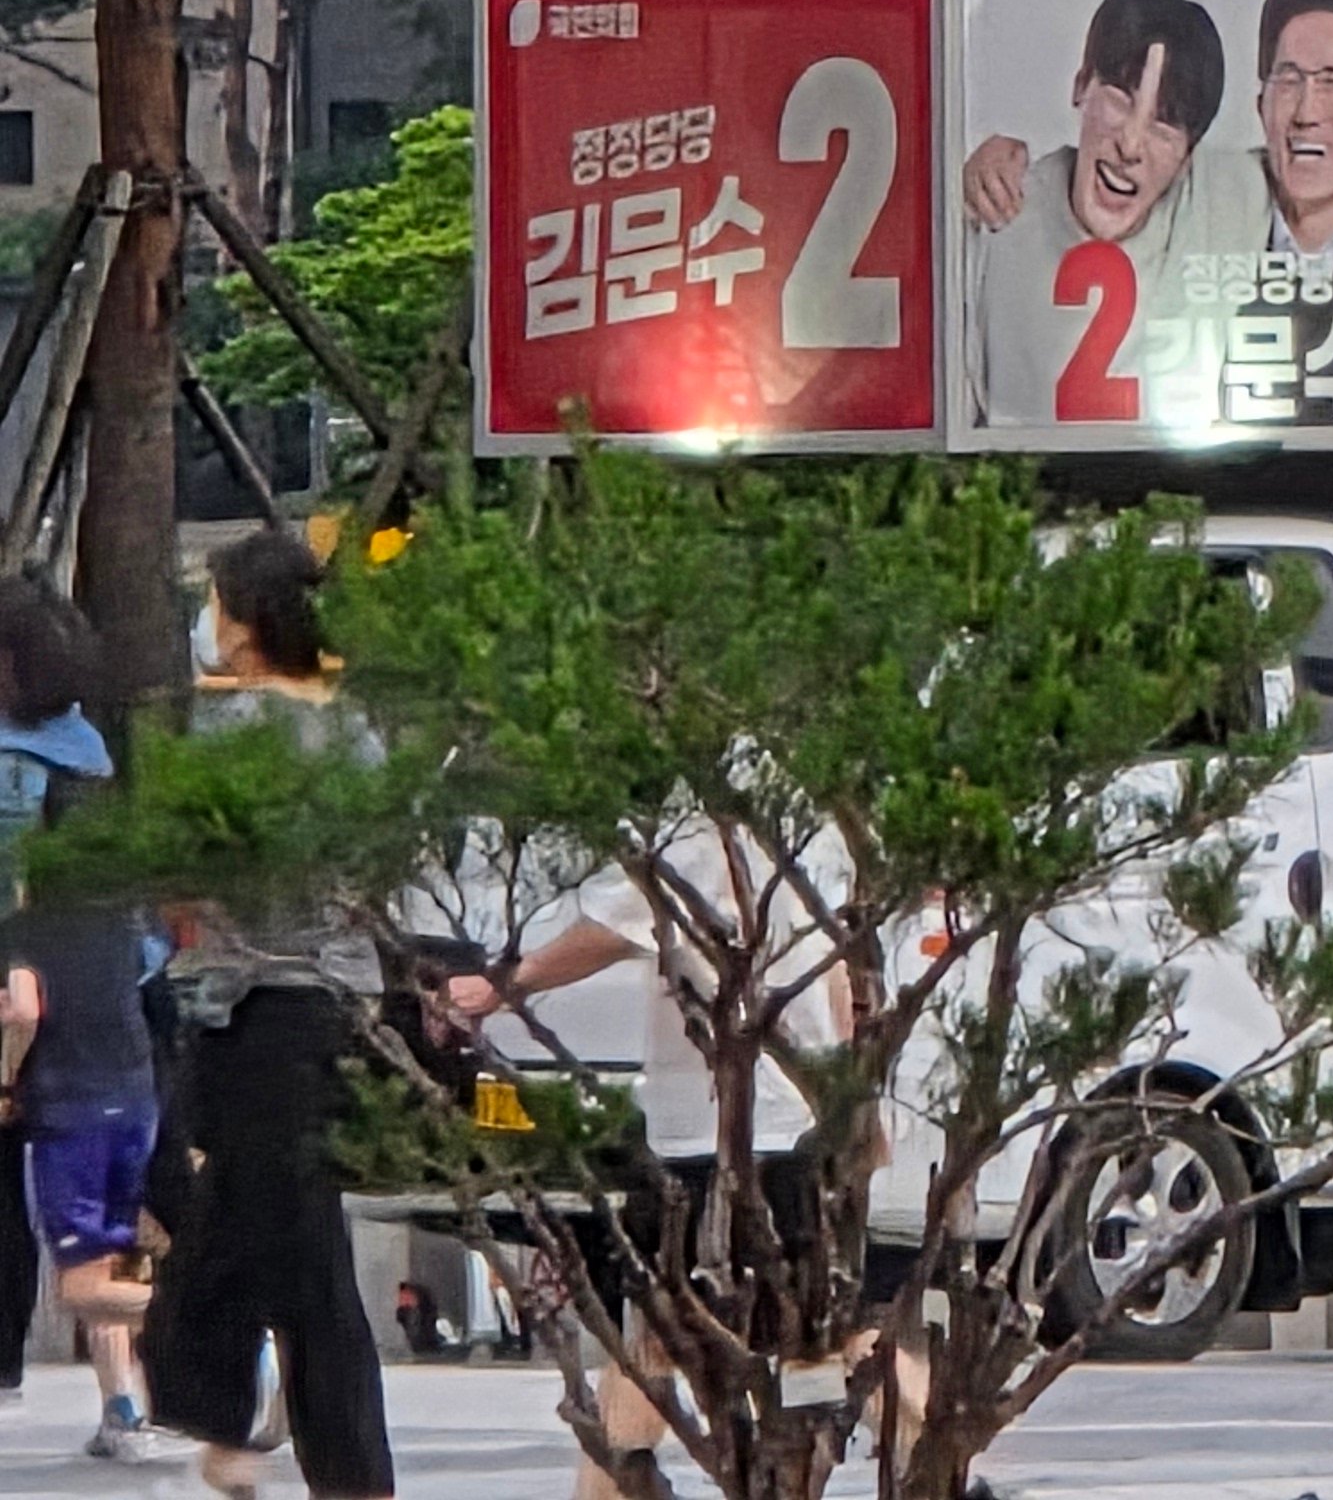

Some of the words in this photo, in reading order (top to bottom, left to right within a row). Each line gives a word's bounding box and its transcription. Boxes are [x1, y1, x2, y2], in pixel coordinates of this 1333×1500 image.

[524, 175, 766, 340] 김문수
[778, 56, 901, 349] 2
[1053, 238, 1140, 422] 2
